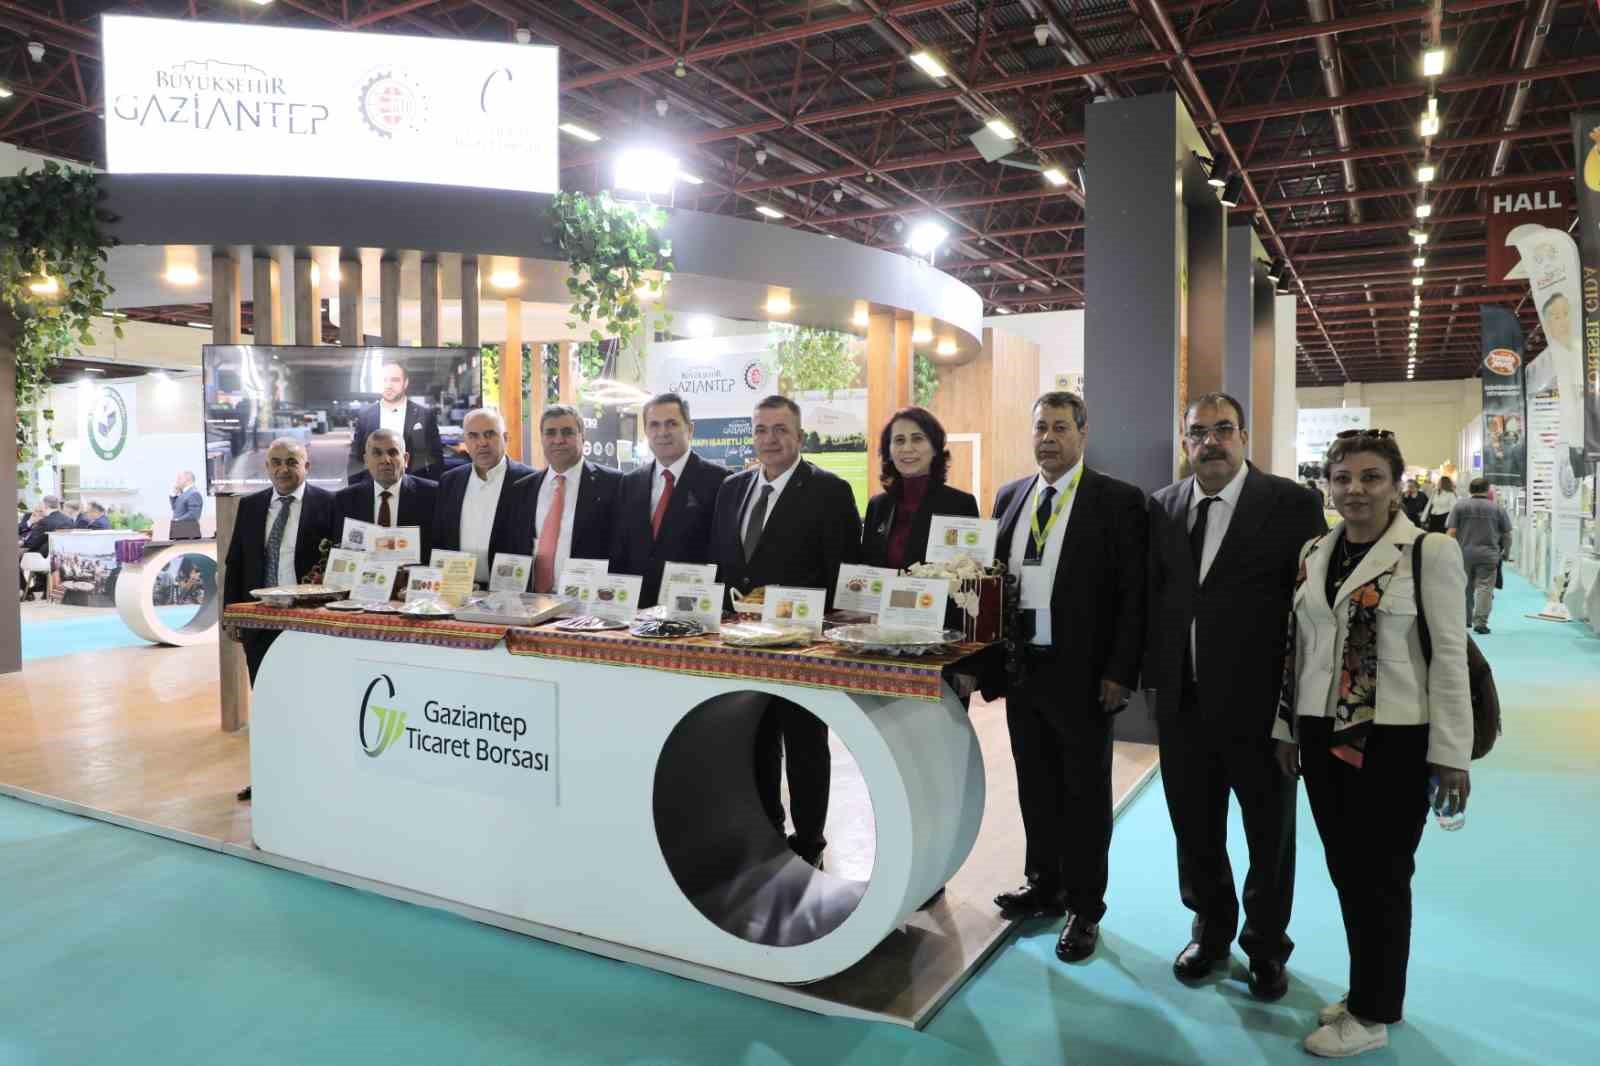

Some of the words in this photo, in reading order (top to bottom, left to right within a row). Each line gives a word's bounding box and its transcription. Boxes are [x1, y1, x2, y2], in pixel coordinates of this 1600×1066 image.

[1493, 190, 1562, 214] HALL
[424, 699, 527, 741] Gaziantep
[406, 727, 471, 759] Ticaret
[476, 737, 549, 772] Borsası
